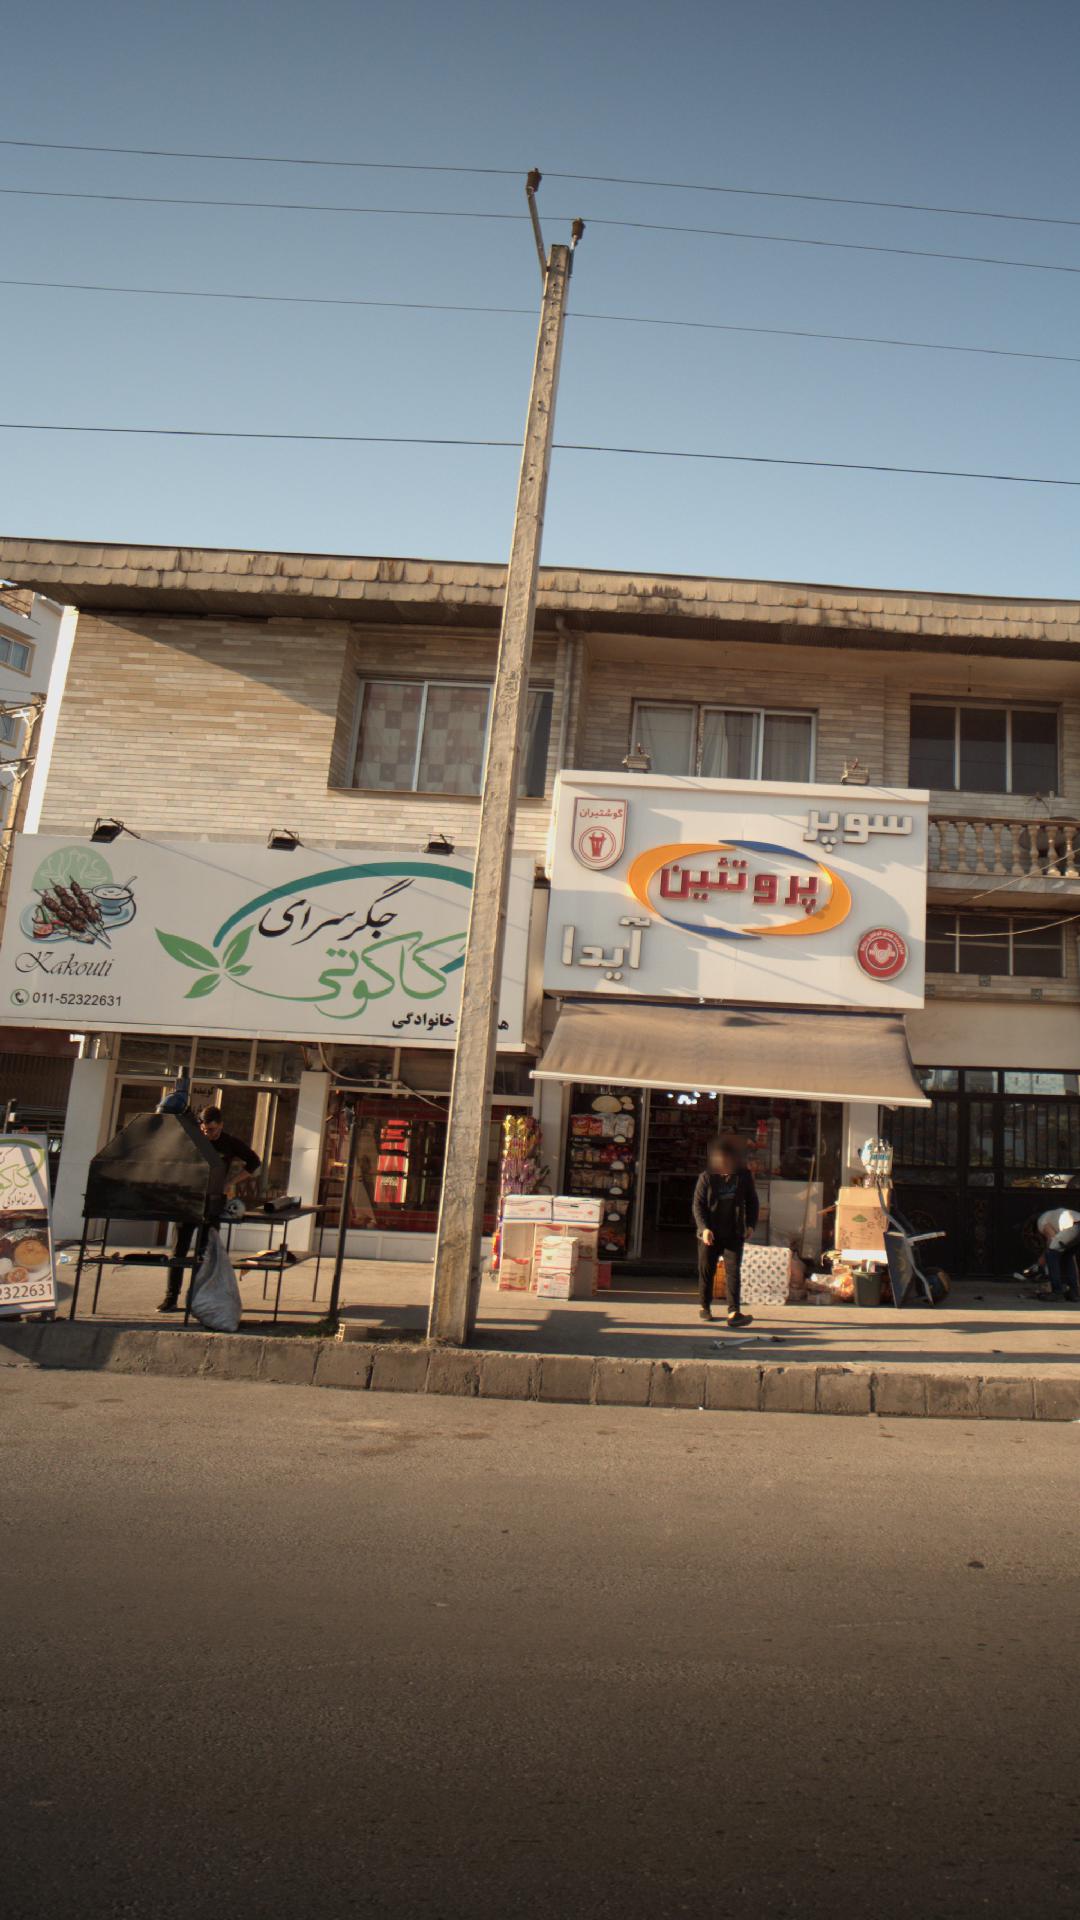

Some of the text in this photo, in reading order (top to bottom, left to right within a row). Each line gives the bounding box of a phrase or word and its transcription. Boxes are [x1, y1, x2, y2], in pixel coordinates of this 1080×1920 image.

[580, 808, 623, 820] گوشتیران
[803, 809, 914, 853] سوپر
[660, 856, 820, 914] پروتئین
[15, 951, 116, 977] Kakouti
[561, 915, 652, 980] آیدا
[250, 930, 468, 1020] کاکوتی
[32, 992, 122, 1007] 011-52322631
[392, 1011, 455, 1031] خانوادگی
